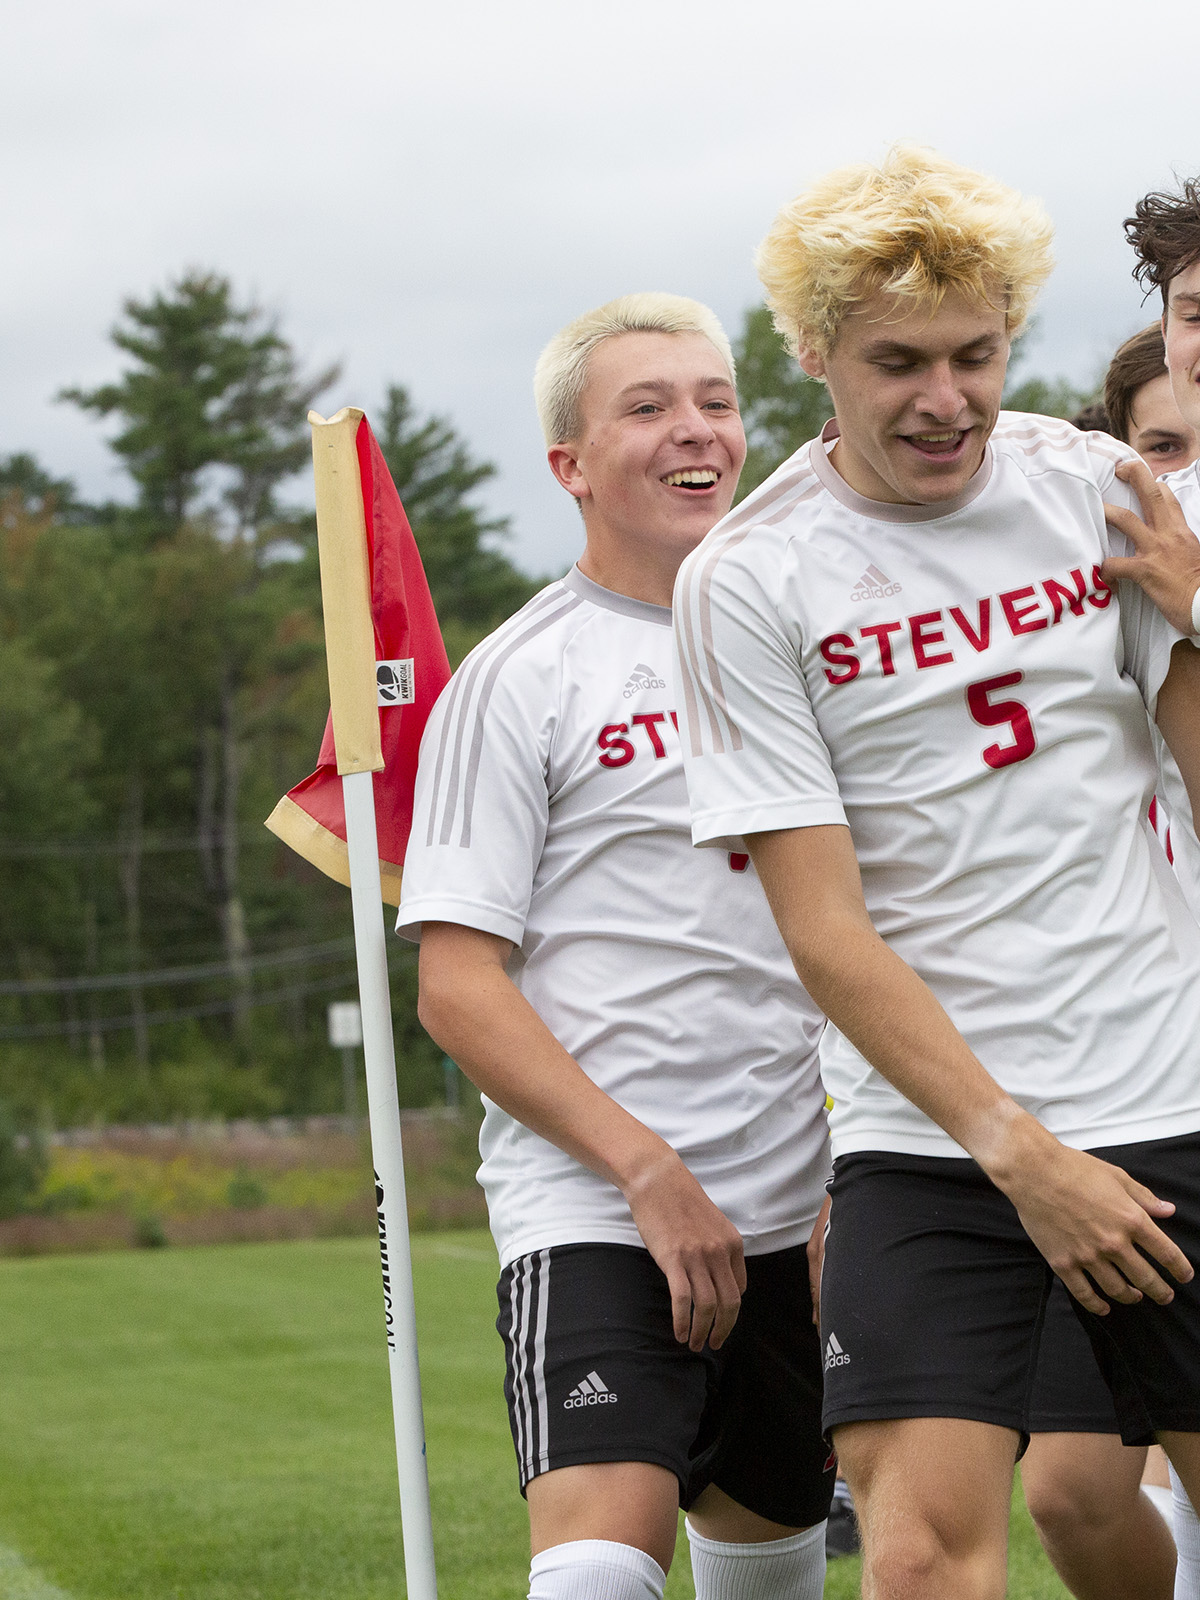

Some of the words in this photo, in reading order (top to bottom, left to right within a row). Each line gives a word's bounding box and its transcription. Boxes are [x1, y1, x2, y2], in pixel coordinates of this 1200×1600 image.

[850, 580, 903, 603] adidas
[818, 563, 1113, 687] STEVENS
[400, 664, 409, 699] KWIKGOAL
[622, 676, 667, 699] adidas
[964, 667, 1038, 770] 5
[596, 709, 680, 770] ST
[563, 1392, 618, 1409] adidas
